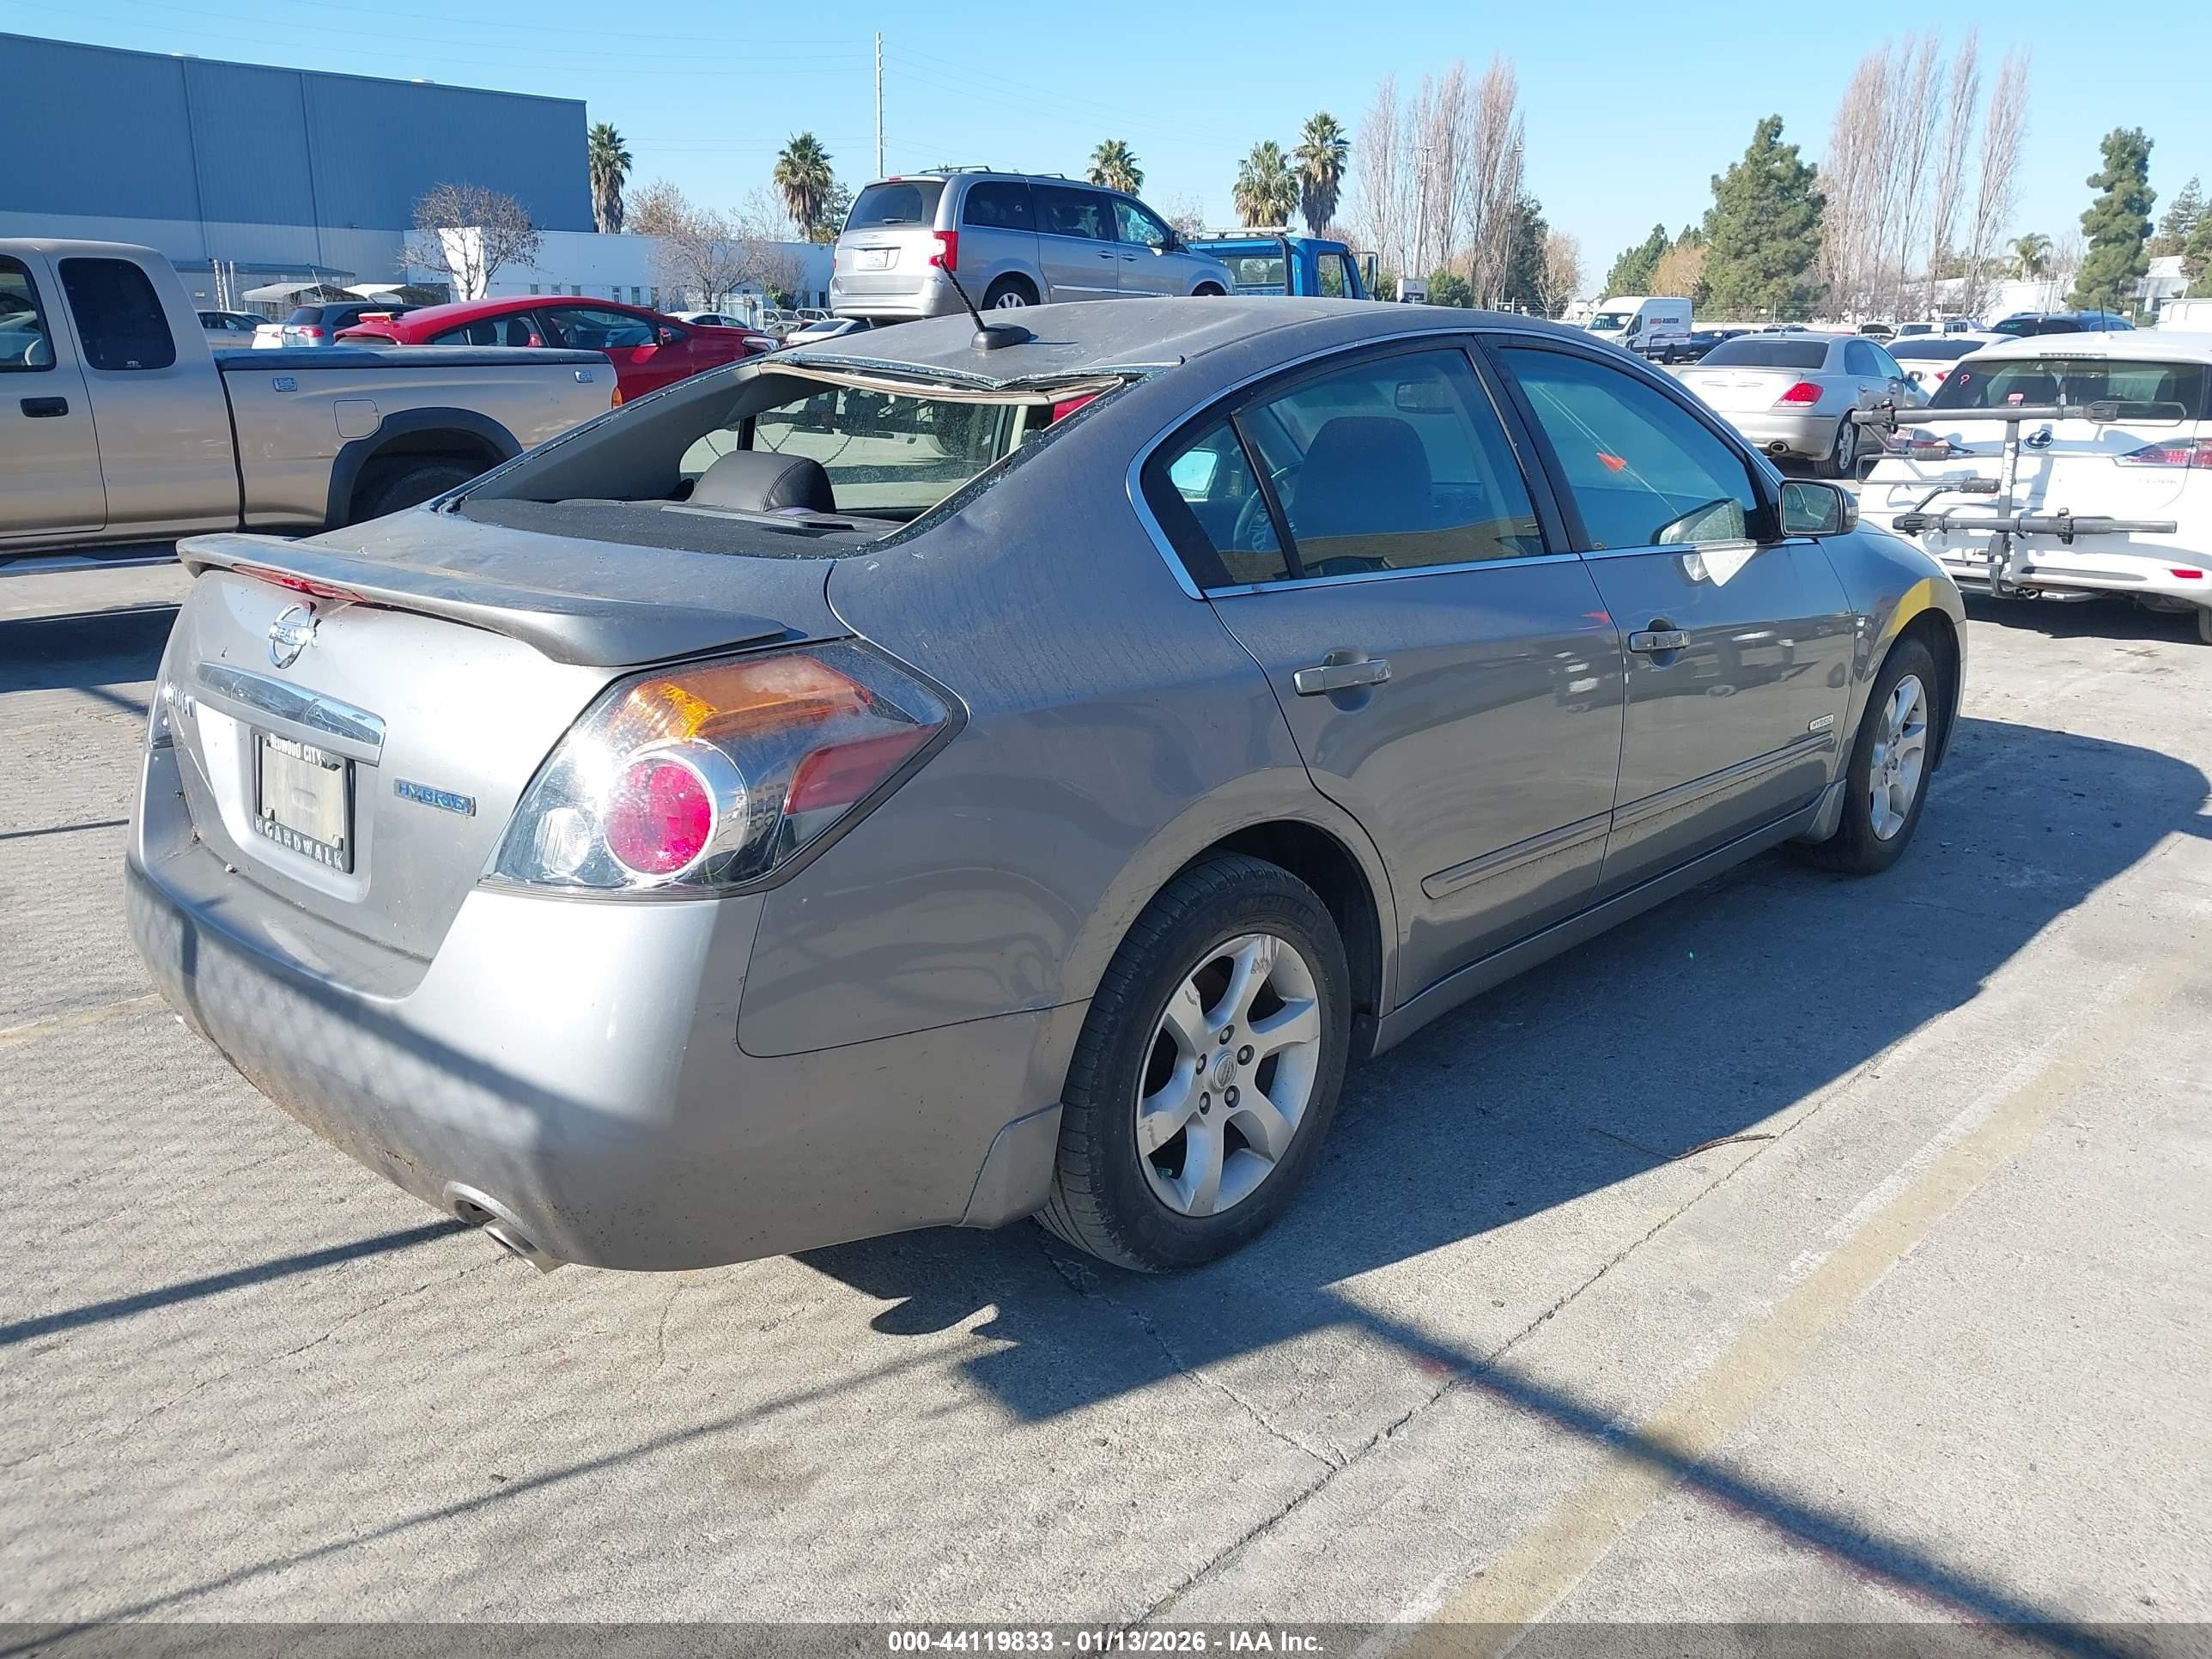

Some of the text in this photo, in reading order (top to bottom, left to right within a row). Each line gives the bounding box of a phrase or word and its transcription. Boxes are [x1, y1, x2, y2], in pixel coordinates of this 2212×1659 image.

[1812, 715, 1833, 729] HYBRID
[303, 744, 322, 764] CITY
[398, 781, 469, 811] HYBRID
